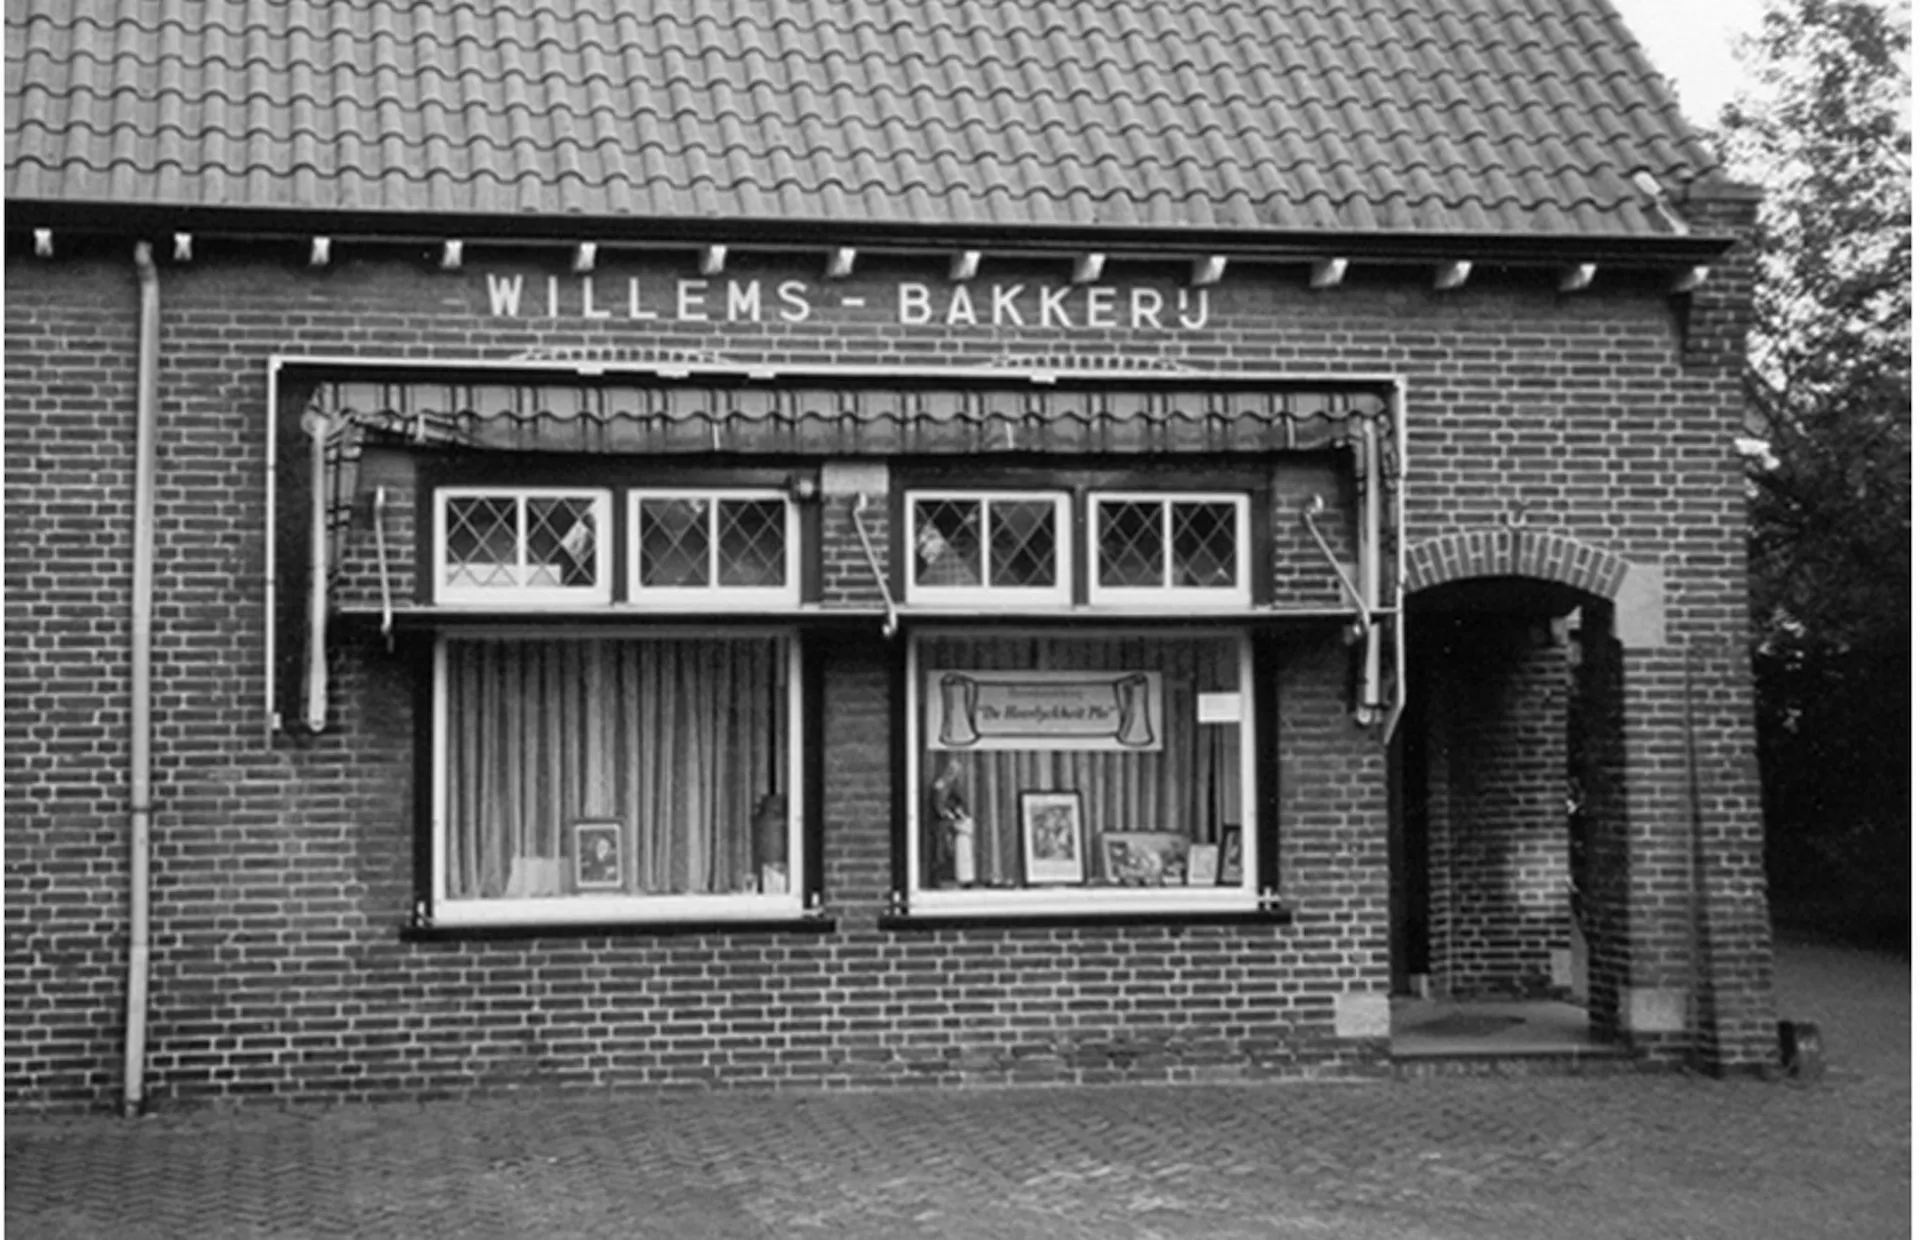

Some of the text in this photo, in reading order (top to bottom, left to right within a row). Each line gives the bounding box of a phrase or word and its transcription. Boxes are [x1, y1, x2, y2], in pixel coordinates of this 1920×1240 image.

[486, 273, 1209, 330] WILLEMS - BAKKERIJ
